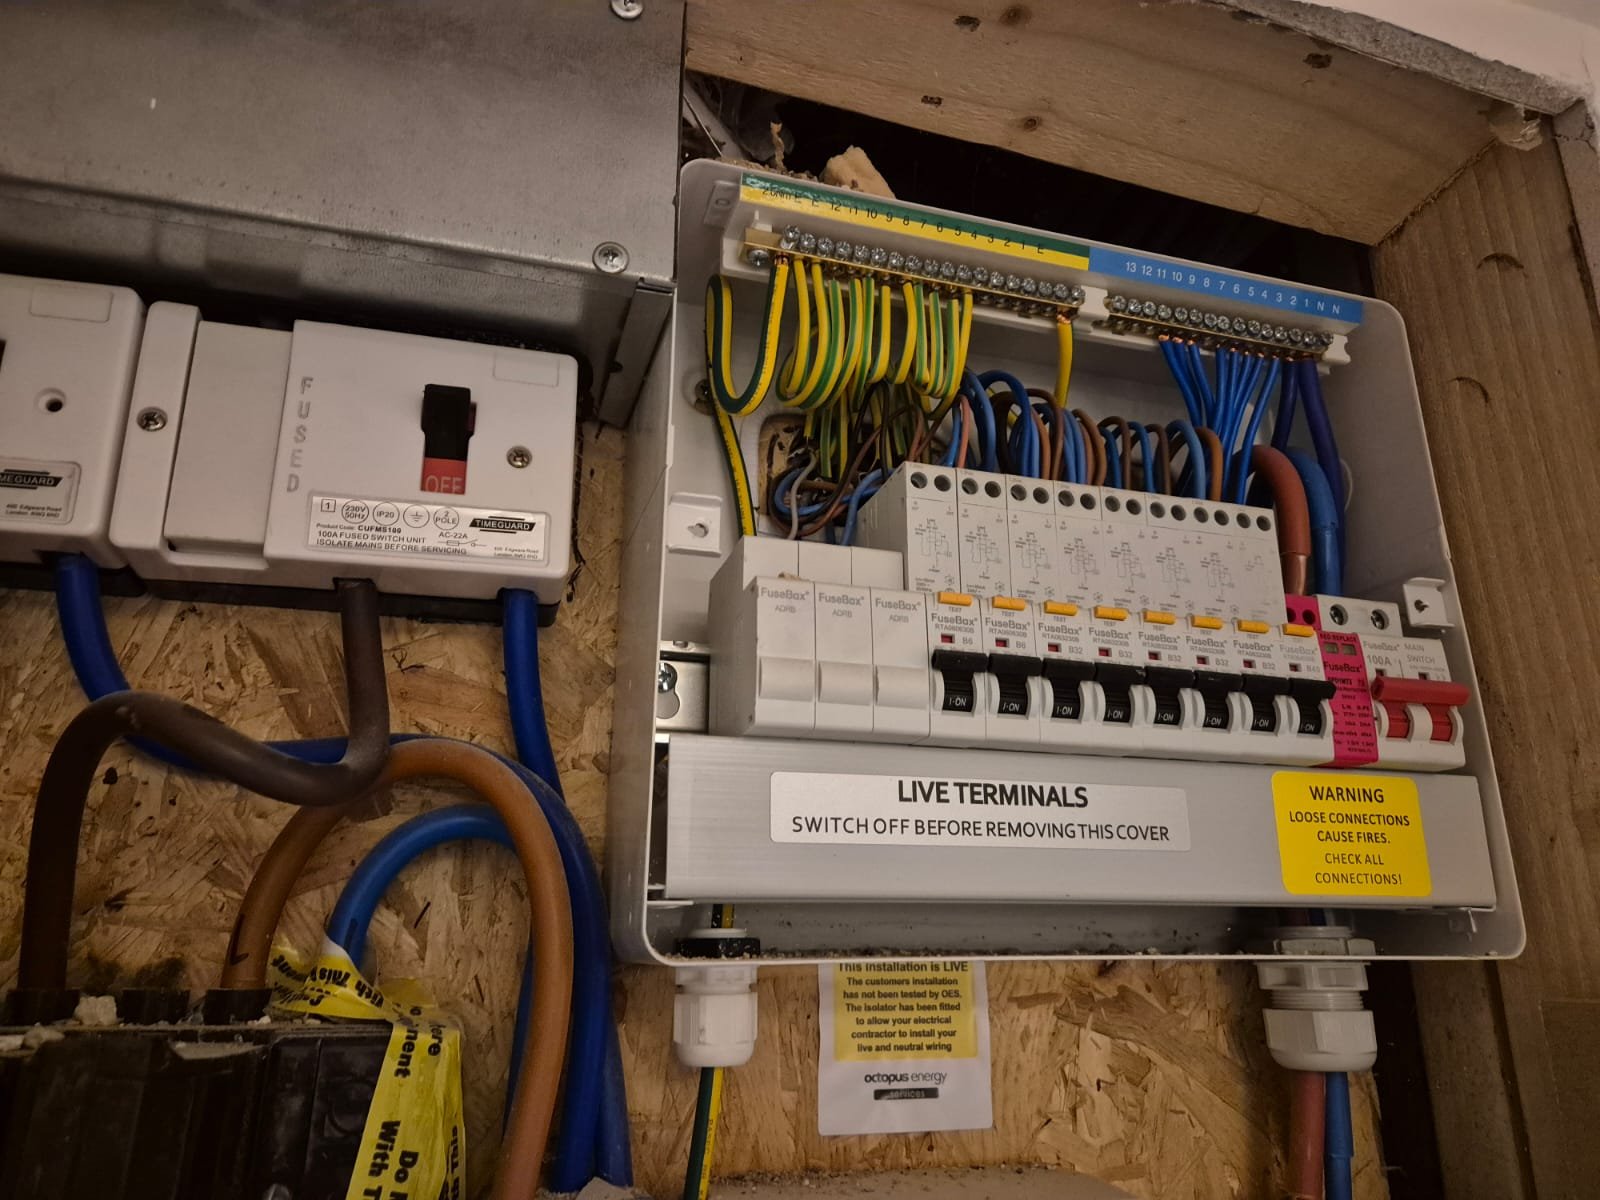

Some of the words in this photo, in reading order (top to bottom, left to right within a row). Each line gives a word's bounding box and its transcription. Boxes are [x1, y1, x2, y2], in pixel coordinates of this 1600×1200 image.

[866, 208, 878, 219] 10
[886, 212, 894, 222] 9
[902, 215, 910, 226] 8
[920, 218, 928, 228] 7
[936, 222, 944, 232] 6
[954, 226, 962, 236] 5
[970, 230, 978, 240] 4
[987, 233, 994, 244] 3
[1004, 236, 1011, 247] 2
[1126, 261, 1136, 272] 13
[1142, 264, 1152, 276] 12
[1157, 268, 1166, 278] 11
[1172, 271, 1182, 282] 10
[1188, 274, 1196, 284] 9
[1203, 277, 1210, 288] 8
[1219, 280, 1226, 290] 7
[1233, 284, 1240, 294] 6
[1248, 286, 1254, 296] 5
[1261, 290, 1268, 300] 4
[1276, 292, 1282, 302] 3
[1290, 296, 1296, 305] 2
[1316, 302, 1324, 311] N
[1332, 305, 1340, 314] N
[425, 475, 463, 494] OFF
[476, 520, 530, 530] TIMEGUARD
[340, 532, 369, 540] FUSED
[370, 534, 405, 542] SWITCH
[316, 539, 354, 548] ISOLATE
[355, 541, 382, 549] MAINS
[384, 544, 418, 552] BEFORE
[421, 546, 467, 554] SERVICING
[1404, 643, 1424, 652] MAIN
[1367, 655, 1392, 666] 100A
[1407, 655, 1436, 664] SWITCH
[898, 780, 948, 803] LIVE
[954, 782, 1088, 808] TERMINALS
[1309, 785, 1384, 803] WARNING
[1289, 811, 1326, 824] LOOSE
[1328, 812, 1410, 826] CONNECTIONS
[792, 816, 870, 834] SWITCH
[872, 818, 910, 835] OFF
[914, 819, 983, 836] BEFORE
[986, 821, 1076, 840] REMOVING
[1080, 823, 1114, 840] THIS
[1116, 824, 1170, 842] COVER
[1317, 830, 1354, 842] CAUSE
[1357, 832, 1390, 844] FIRES.
[1325, 853, 1362, 864] CHECK
[1364, 854, 1384, 865] ALL
[1315, 872, 1402, 885] CONNECTIONS!
[930, 962, 940, 972] is
[943, 961, 968, 972] LIVE
[846, 976, 863, 986] The
[865, 978, 910, 986] customers
[912, 976, 958, 986] installation
[843, 990, 859, 998] has
[861, 990, 876, 999] not
[877, 990, 898, 998] been
[900, 990, 927, 998] tested
[929, 989, 939, 1000] by
[846, 1004, 862, 1012] The
[864, 1003, 896, 1012] isolator
[899, 1003, 914, 1011] has
[916, 1003, 937, 1011] been
[939, 1002, 960, 1011] fitted
[856, 1017, 864, 1025] to
[867, 1016, 890, 1025] allow
[892, 1018, 911, 1026] your
[914, 1016, 952, 1024] electrical
[851, 1030, 896, 1038] contractor
[898, 1030, 908, 1038] to
[910, 1029, 935, 1037] install
[937, 1030, 956, 1040] your
[857, 1044, 872, 1052] live
[875, 1043, 891, 1052] and
[893, 1042, 924, 1051] neutral
[926, 1042, 952, 1052] wiring
[864, 1072, 910, 1085] octopus
[910, 1072, 947, 1085] energy
[368, 1120, 401, 1177] With
[394, 1151, 420, 1184] Do
